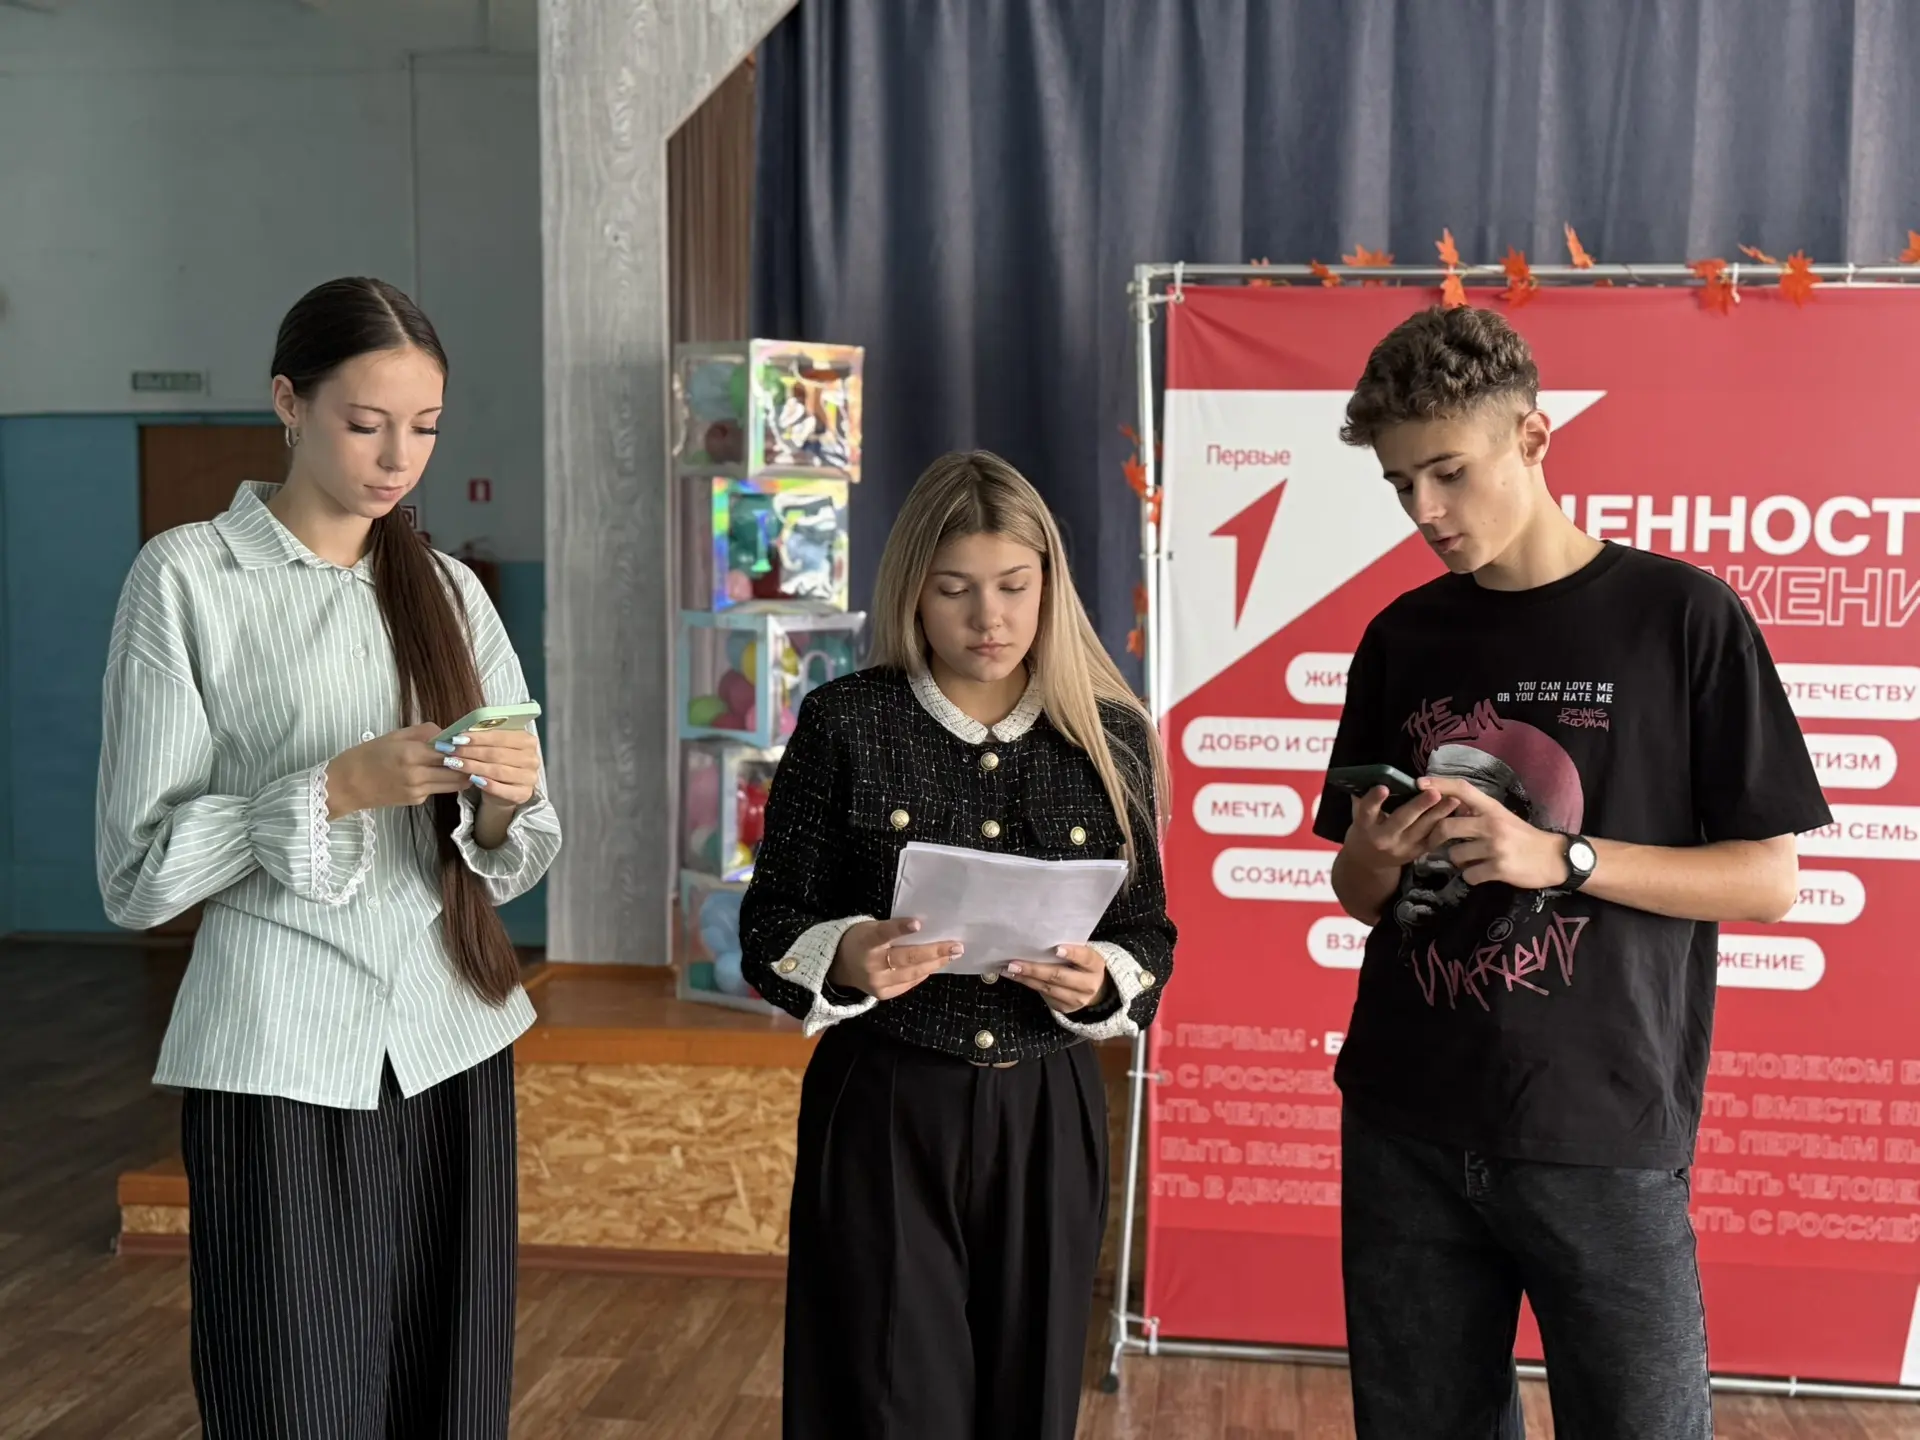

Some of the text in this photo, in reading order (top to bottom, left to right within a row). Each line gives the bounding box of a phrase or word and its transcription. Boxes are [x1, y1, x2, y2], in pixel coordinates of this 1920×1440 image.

[1206, 445, 1291, 470] Первые
[1305, 670, 1348, 688] ЖИ
[1518, 682, 1614, 693] YOU CAN LOVE ME
[1497, 692, 1613, 704] OR YOU CAN HATE ME
[1198, 734, 1280, 752] ДОБРО
[1286, 736, 1300, 751] И
[1811, 753, 1880, 771] ТИЗМ
[1211, 801, 1285, 819] МЕЧТА
[1848, 822, 1919, 841] СЕМЬ
[1794, 888, 1845, 906] ЯТЬ
[1717, 951, 1805, 971] ЖЕНИЕ
